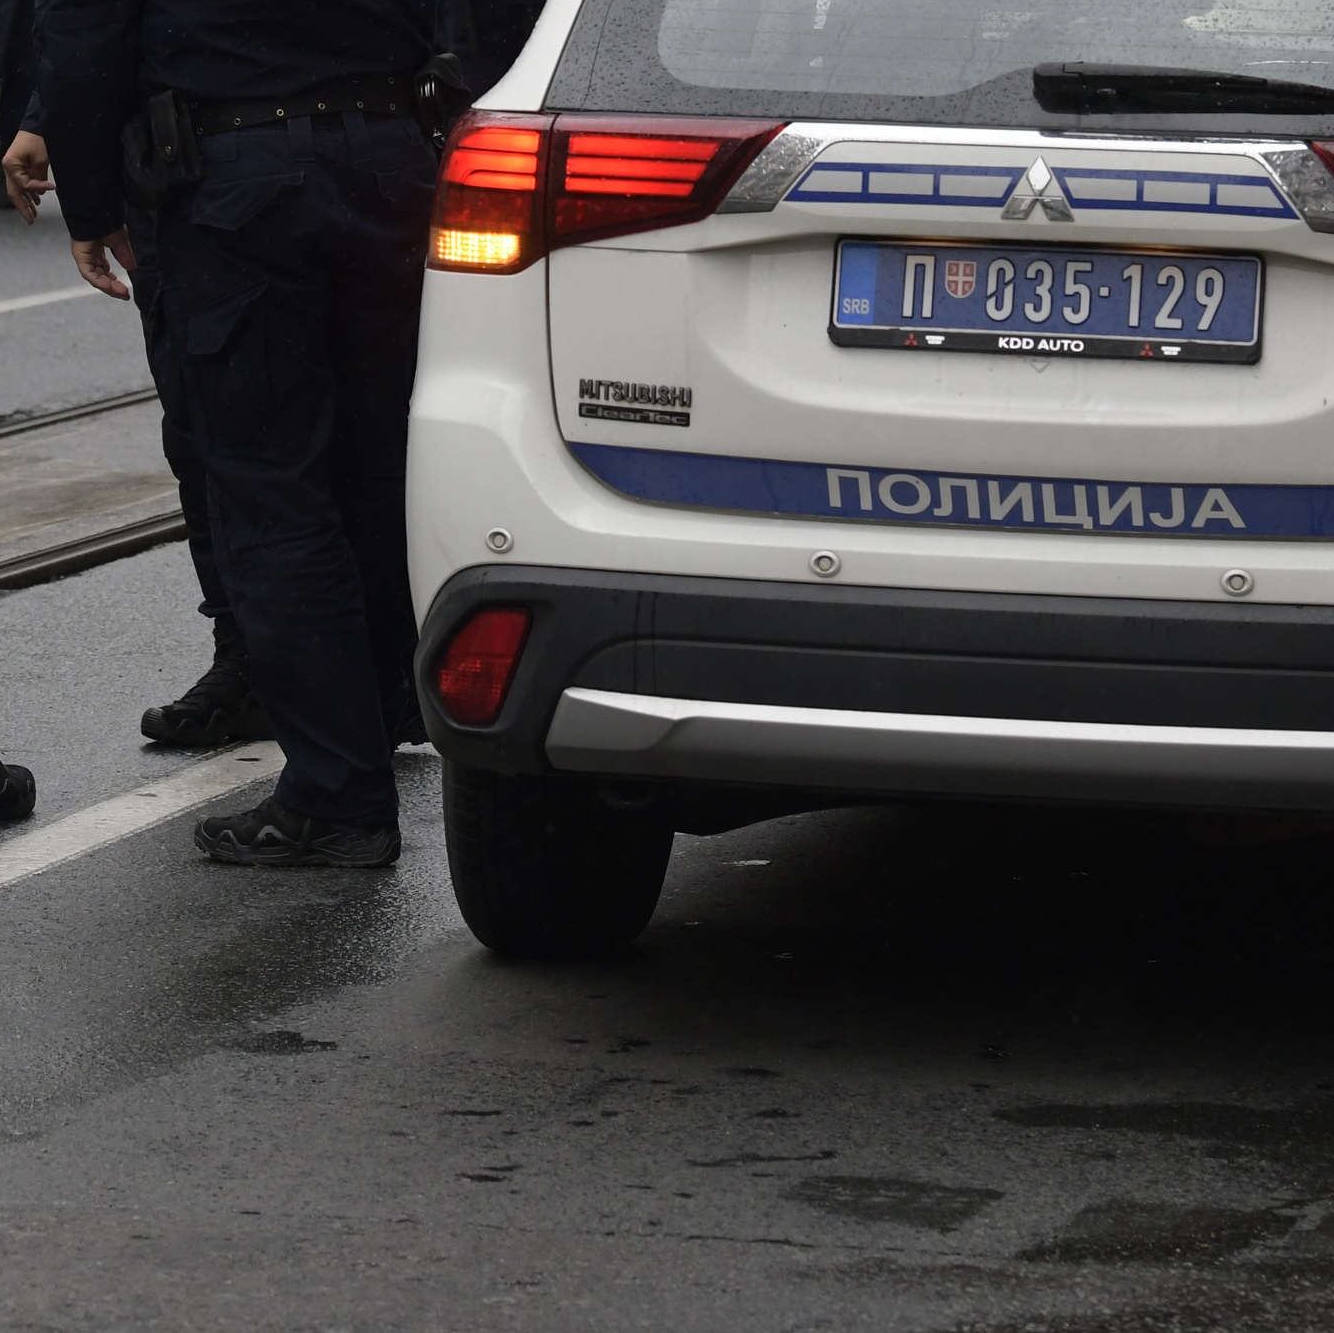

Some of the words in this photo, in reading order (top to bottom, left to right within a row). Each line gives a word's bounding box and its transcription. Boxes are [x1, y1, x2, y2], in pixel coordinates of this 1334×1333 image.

[902, 254, 936, 318] П
[842, 298, 870, 315] SRB
[998, 337, 1034, 350] KDD
[1037, 339, 1084, 352] AUTO
[579, 378, 692, 408] MITSUBISHI
[826, 468, 1247, 530] ПОЛИЦИЈА
